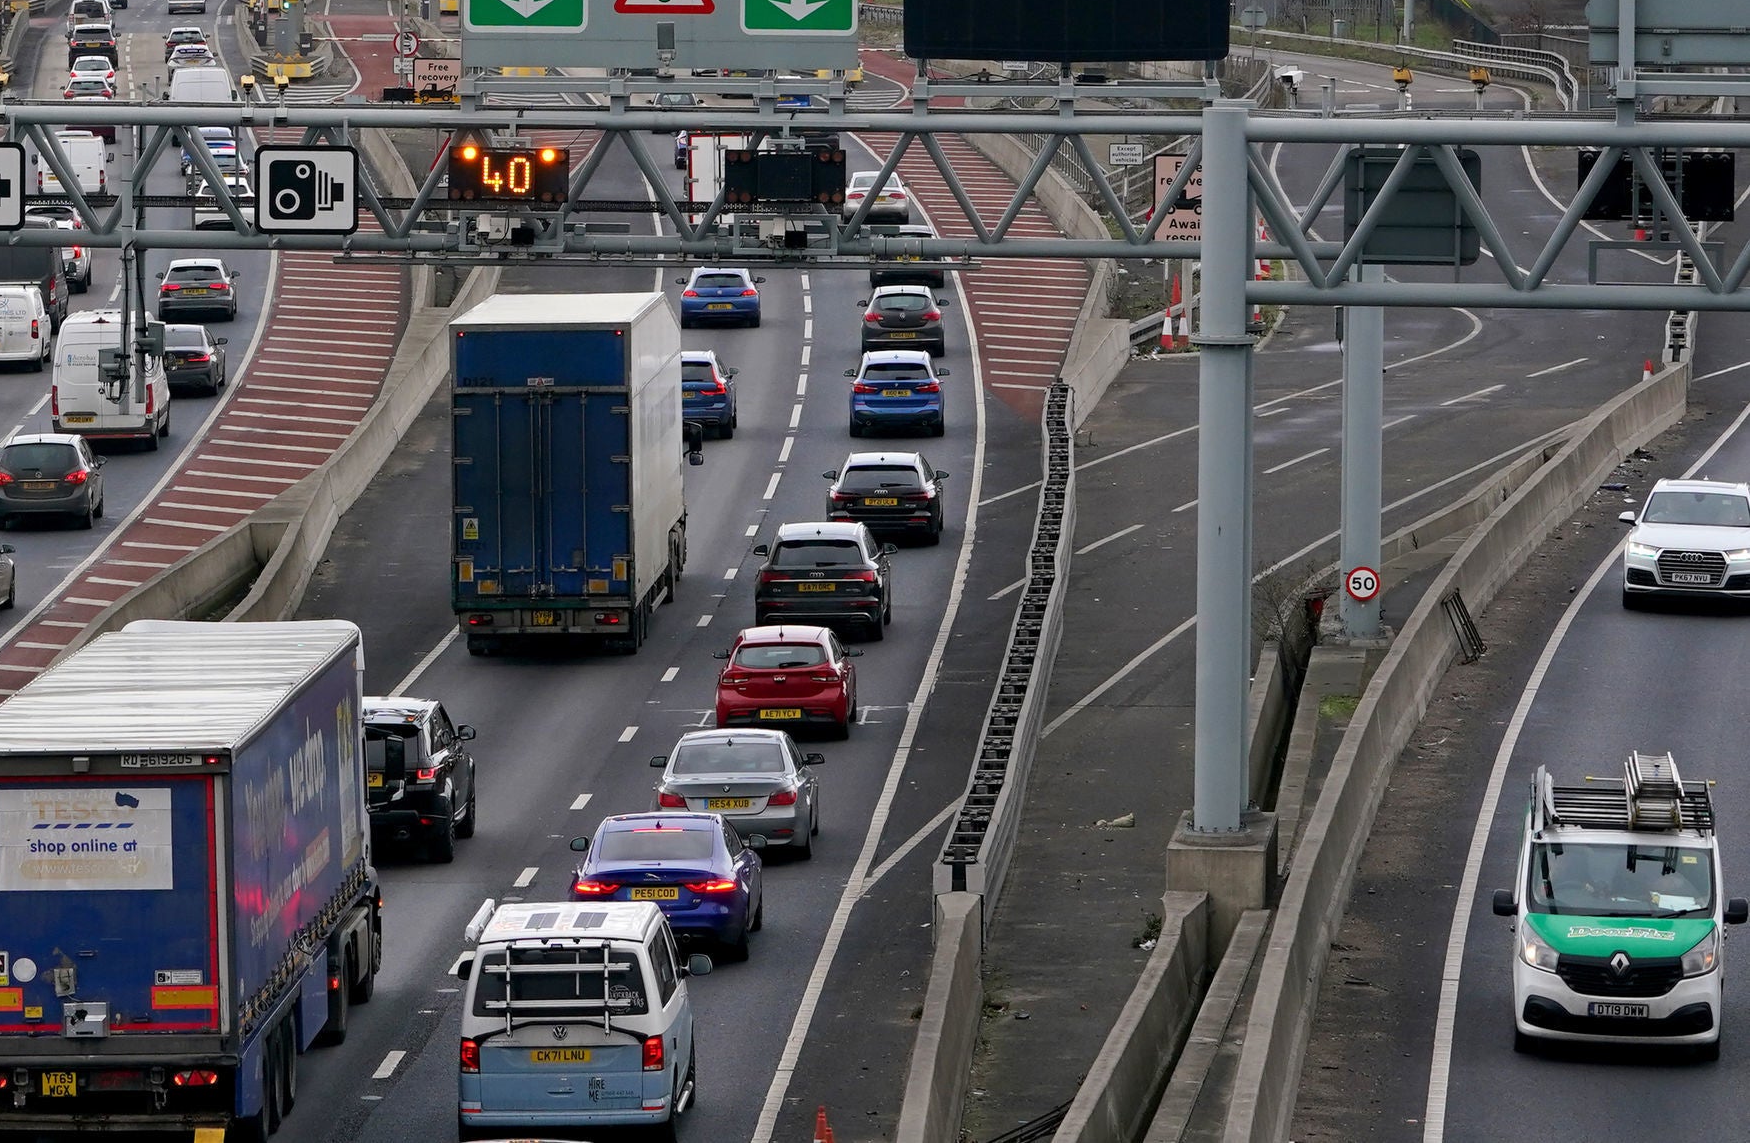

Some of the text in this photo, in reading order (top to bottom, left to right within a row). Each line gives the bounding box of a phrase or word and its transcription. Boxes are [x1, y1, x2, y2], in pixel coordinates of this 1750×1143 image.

[428, 63, 448, 71] Free
[418, 74, 458, 83] recovery
[482, 156, 531, 193] 40
[1169, 218, 1200, 230] Awai
[1352, 577, 1375, 590] 50
[289, 747, 305, 816] we
[709, 798, 750, 808] RE54 XUB
[30, 838, 138, 856] shop online at
[634, 888, 676, 898] PE51 COD
[1597, 1004, 1621, 1016] DT19
[535, 1050, 586, 1061] CK71 LNU
[44, 1073, 74, 1084] YT69
[588, 1077, 605, 1091] HIRE
[588, 1088, 600, 1103] ME
